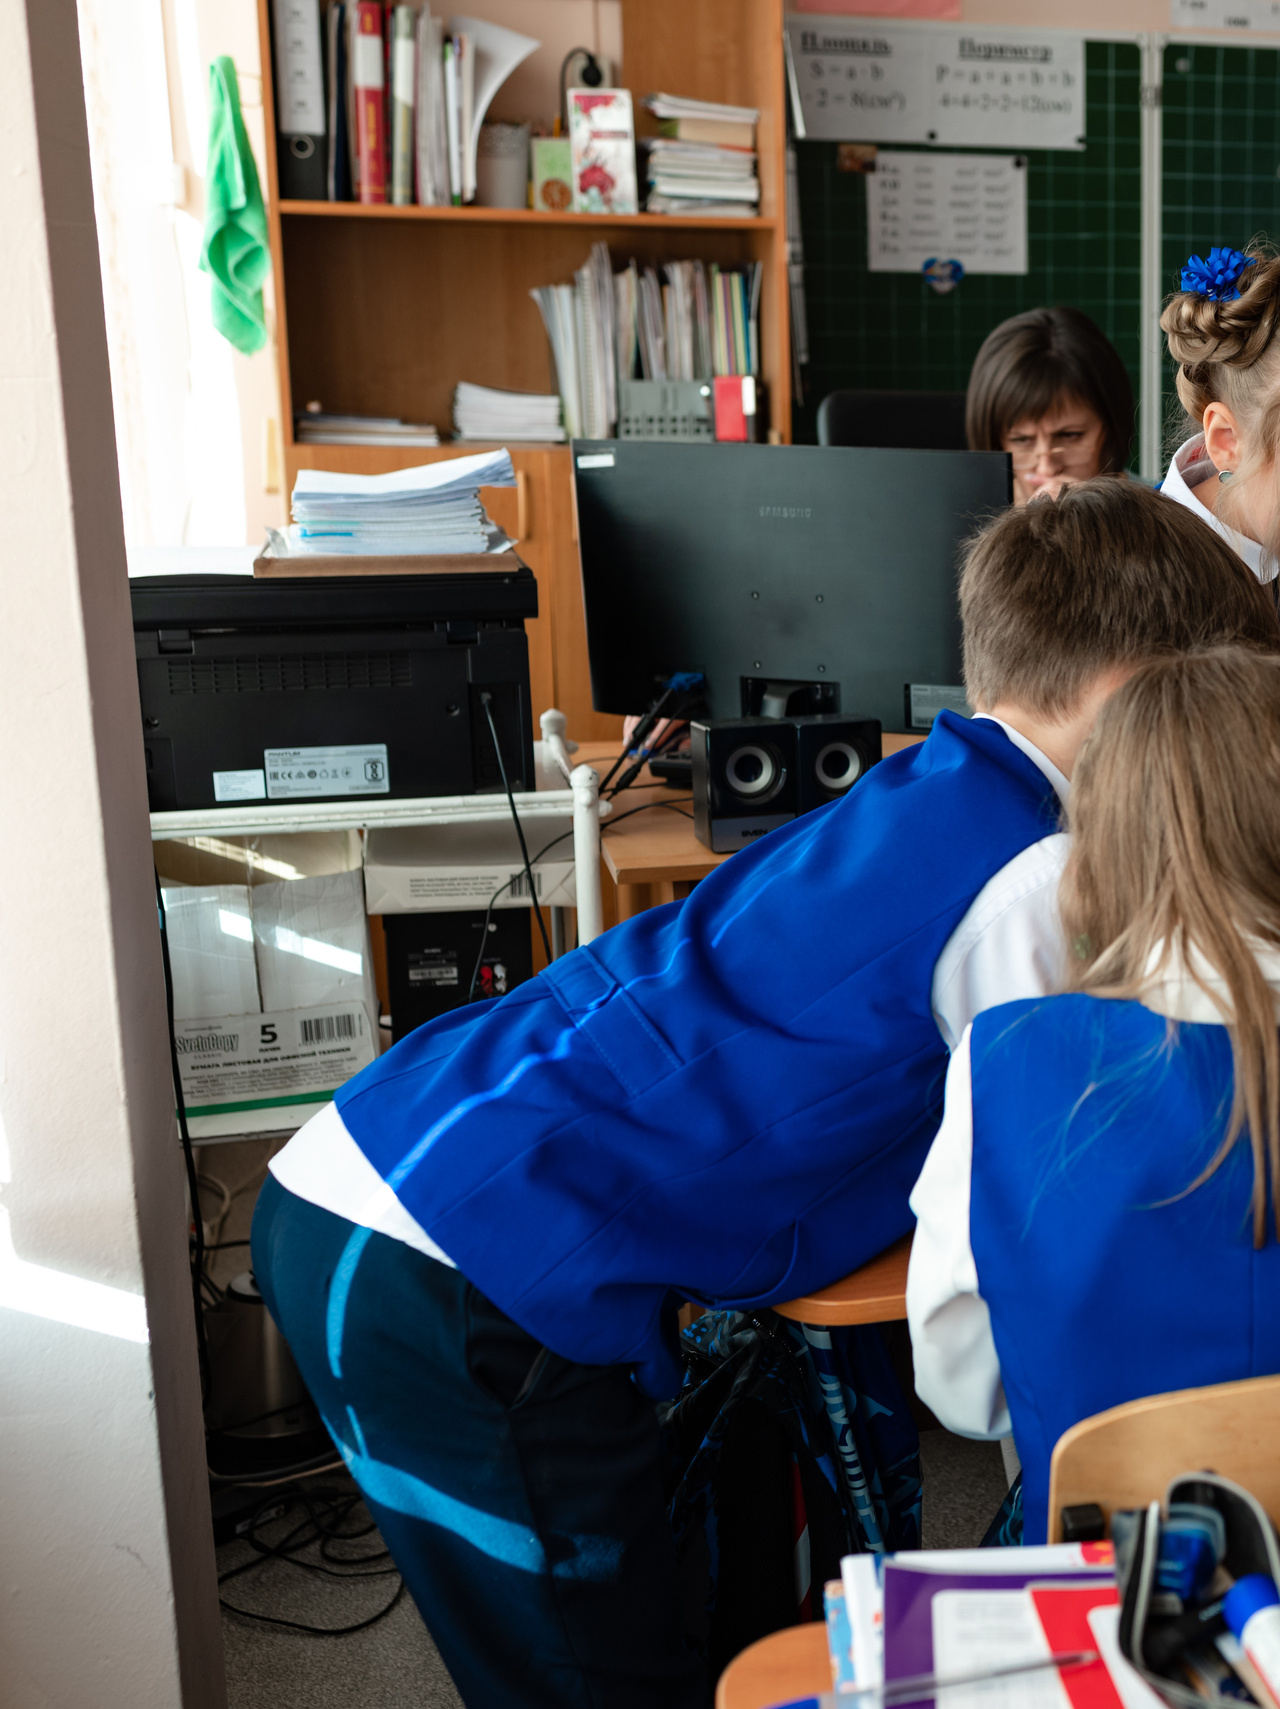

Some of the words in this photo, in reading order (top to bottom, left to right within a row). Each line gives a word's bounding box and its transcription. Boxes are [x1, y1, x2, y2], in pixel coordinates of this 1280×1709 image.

[759, 506, 812, 519] SAMSUNG
[741, 829, 768, 837] SVEN
[260, 1023, 278, 1045] 5
[175, 1033, 239, 1056] SvetoCopy
[190, 1062, 220, 1071] БУМАГА
[263, 1056, 279, 1065] ДЛЯ
